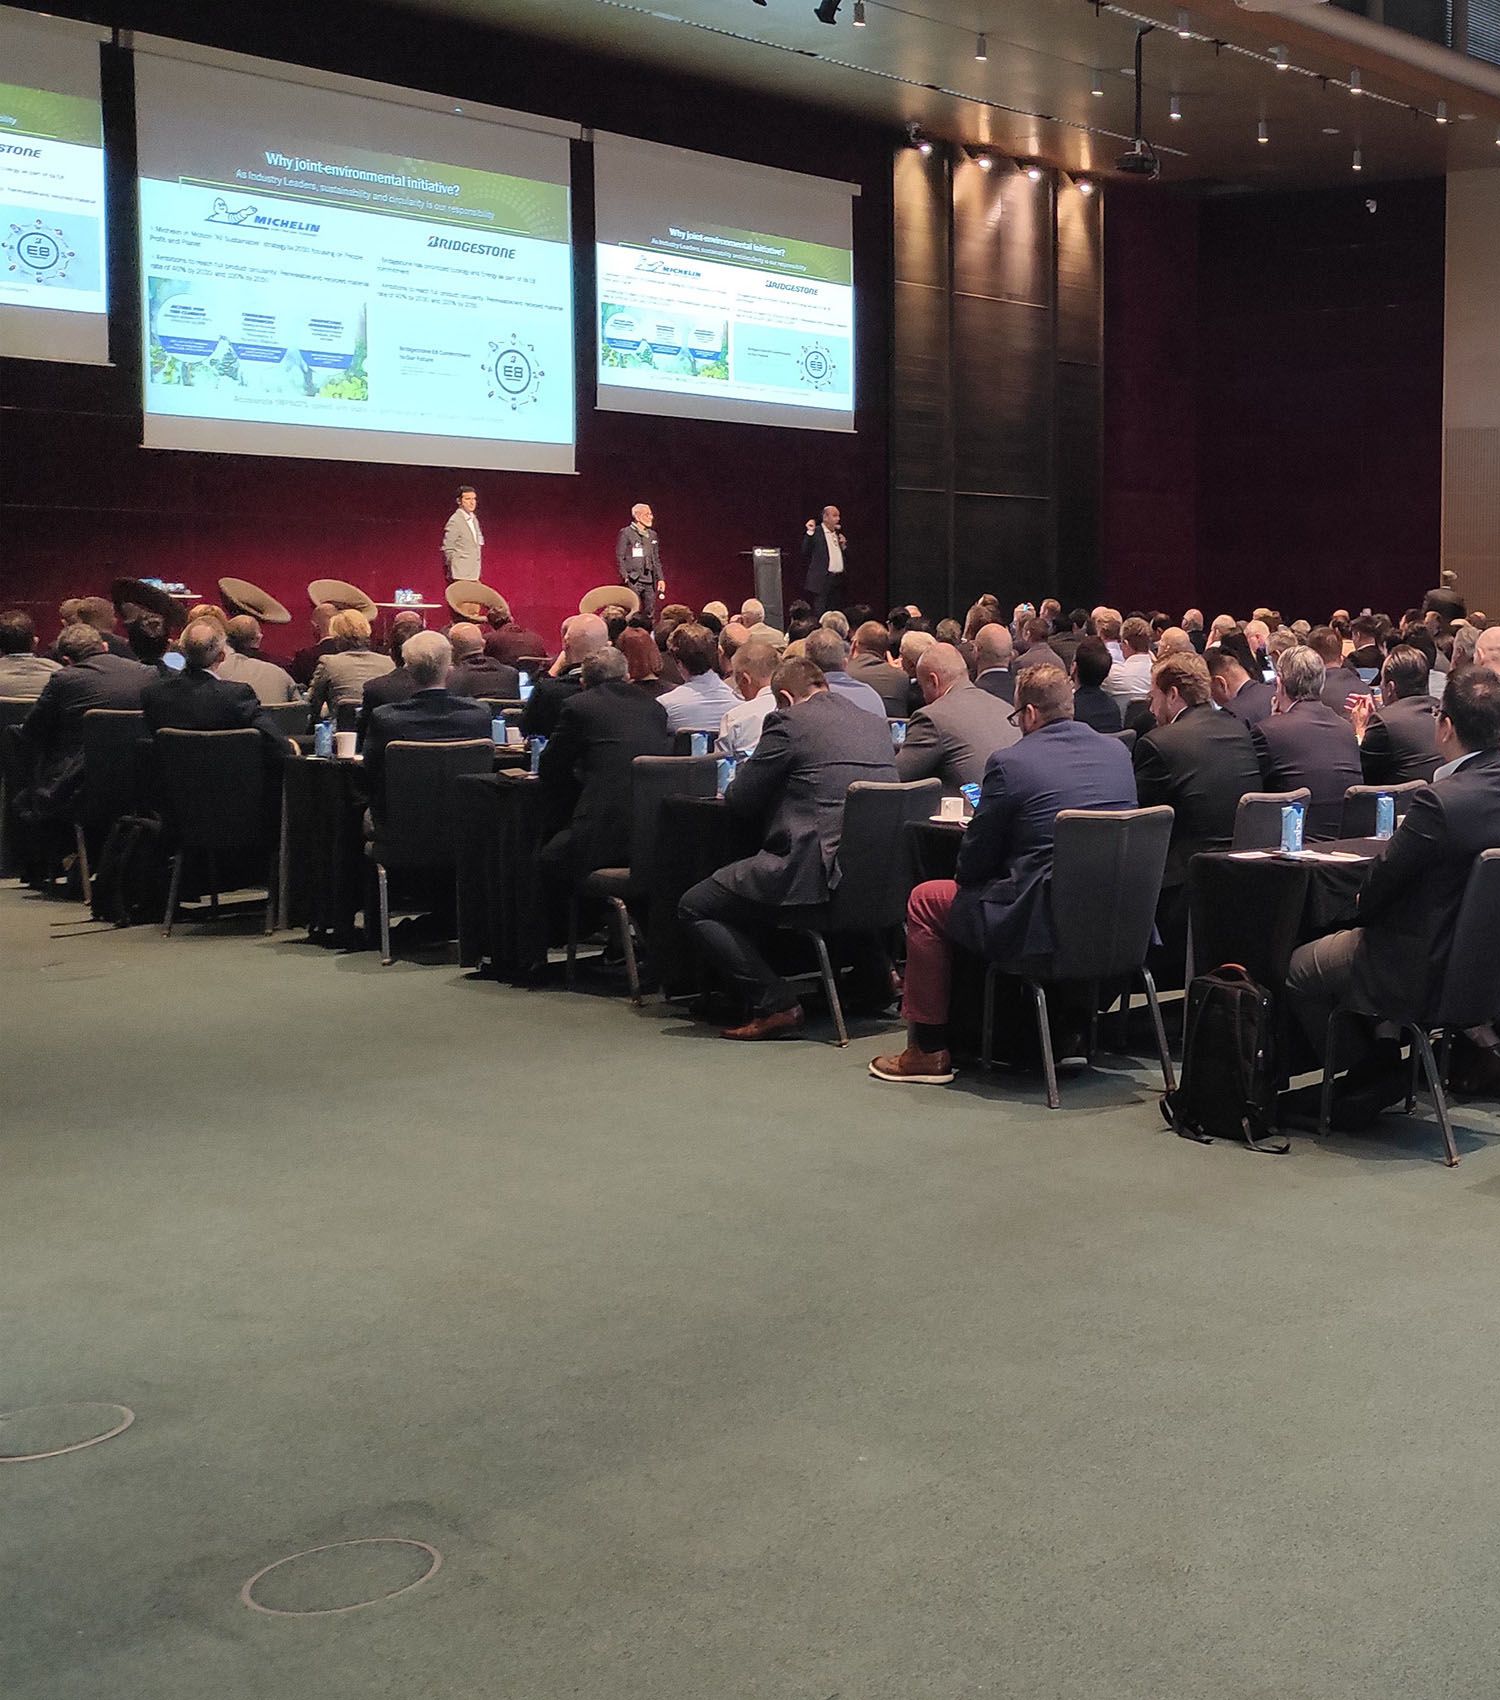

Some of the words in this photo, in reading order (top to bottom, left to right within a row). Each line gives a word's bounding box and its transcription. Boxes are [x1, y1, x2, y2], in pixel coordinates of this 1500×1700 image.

[235, 169, 247, 179] As
[248, 171, 282, 186] Industry
[264, 151, 293, 171] Why
[294, 157, 406, 188] joint-environmental
[407, 176, 460, 196] initiative?
[254, 215, 321, 233] MICHELIN
[427, 235, 516, 259] BRIDGESTONE
